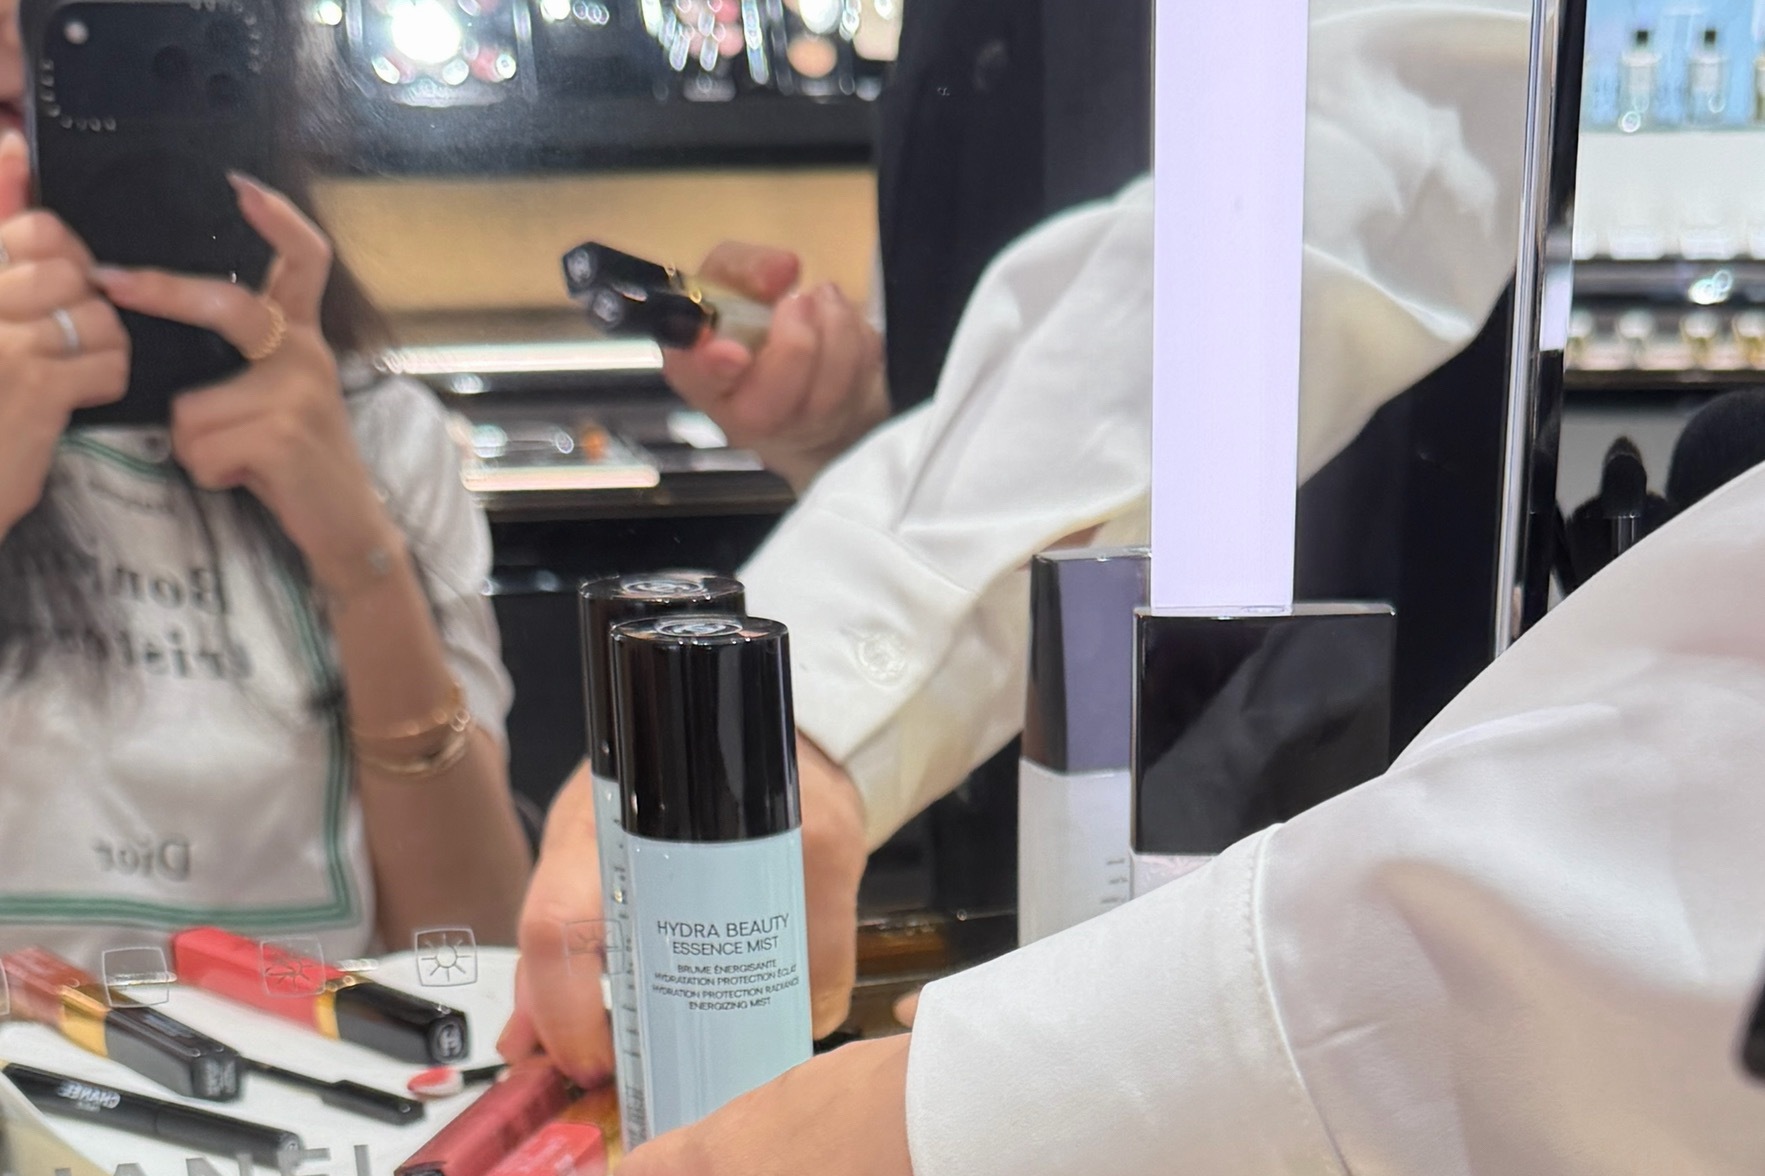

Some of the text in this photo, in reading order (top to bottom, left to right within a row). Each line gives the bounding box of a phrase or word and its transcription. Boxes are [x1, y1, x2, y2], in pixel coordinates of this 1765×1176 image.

[657, 913, 789, 938] HYDRA BEAUTY
[672, 936, 779, 956] ESSENCE MIST
[677, 964, 711, 975] BRUME
[655, 972, 715, 986] HYDRATATION
[717, 971, 776, 986] PROTECTION
[652, 985, 699, 998] HYDRATION
[702, 986, 764, 999] PROTECTION
[749, 997, 771, 1008] MIST
